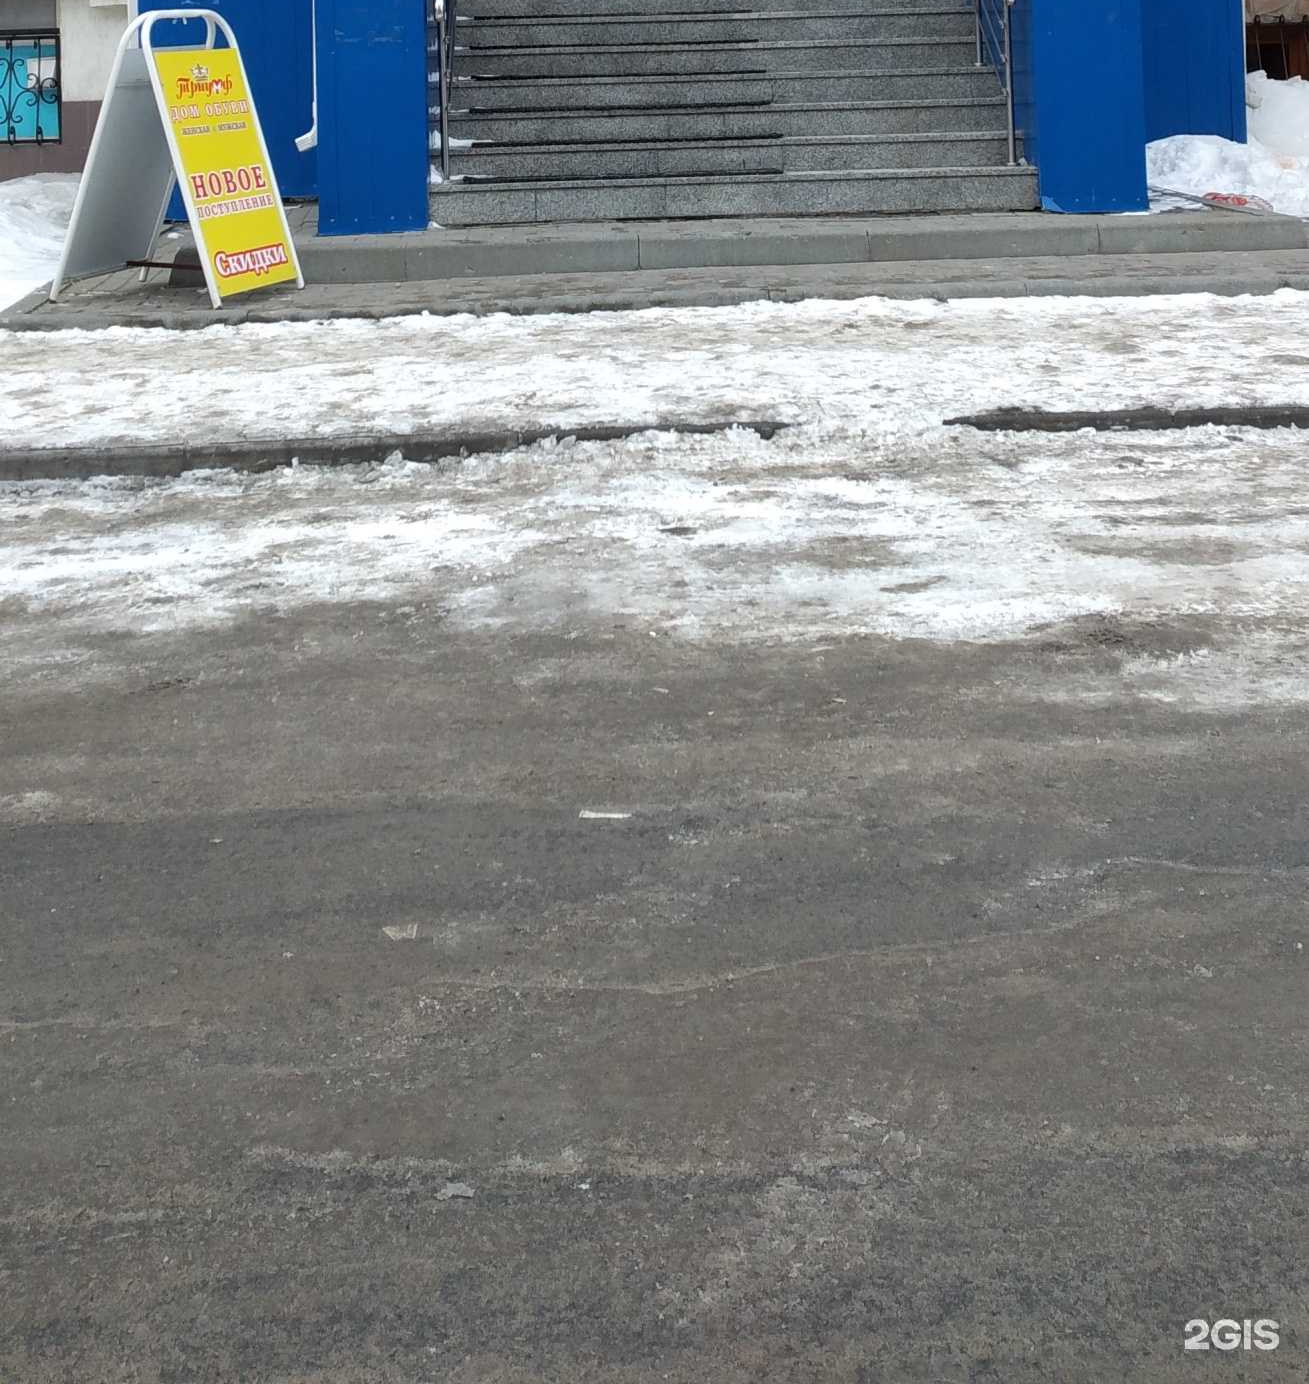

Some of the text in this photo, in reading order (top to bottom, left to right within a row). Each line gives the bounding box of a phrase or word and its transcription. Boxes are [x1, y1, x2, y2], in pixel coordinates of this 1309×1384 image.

[176, 73, 233, 100] Триумф
[169, 99, 249, 122] ДОМ ОБУВИ
[190, 165, 267, 199] НОВОЕ
[196, 194, 274, 219] ПОСТУПЛЕНИЕ
